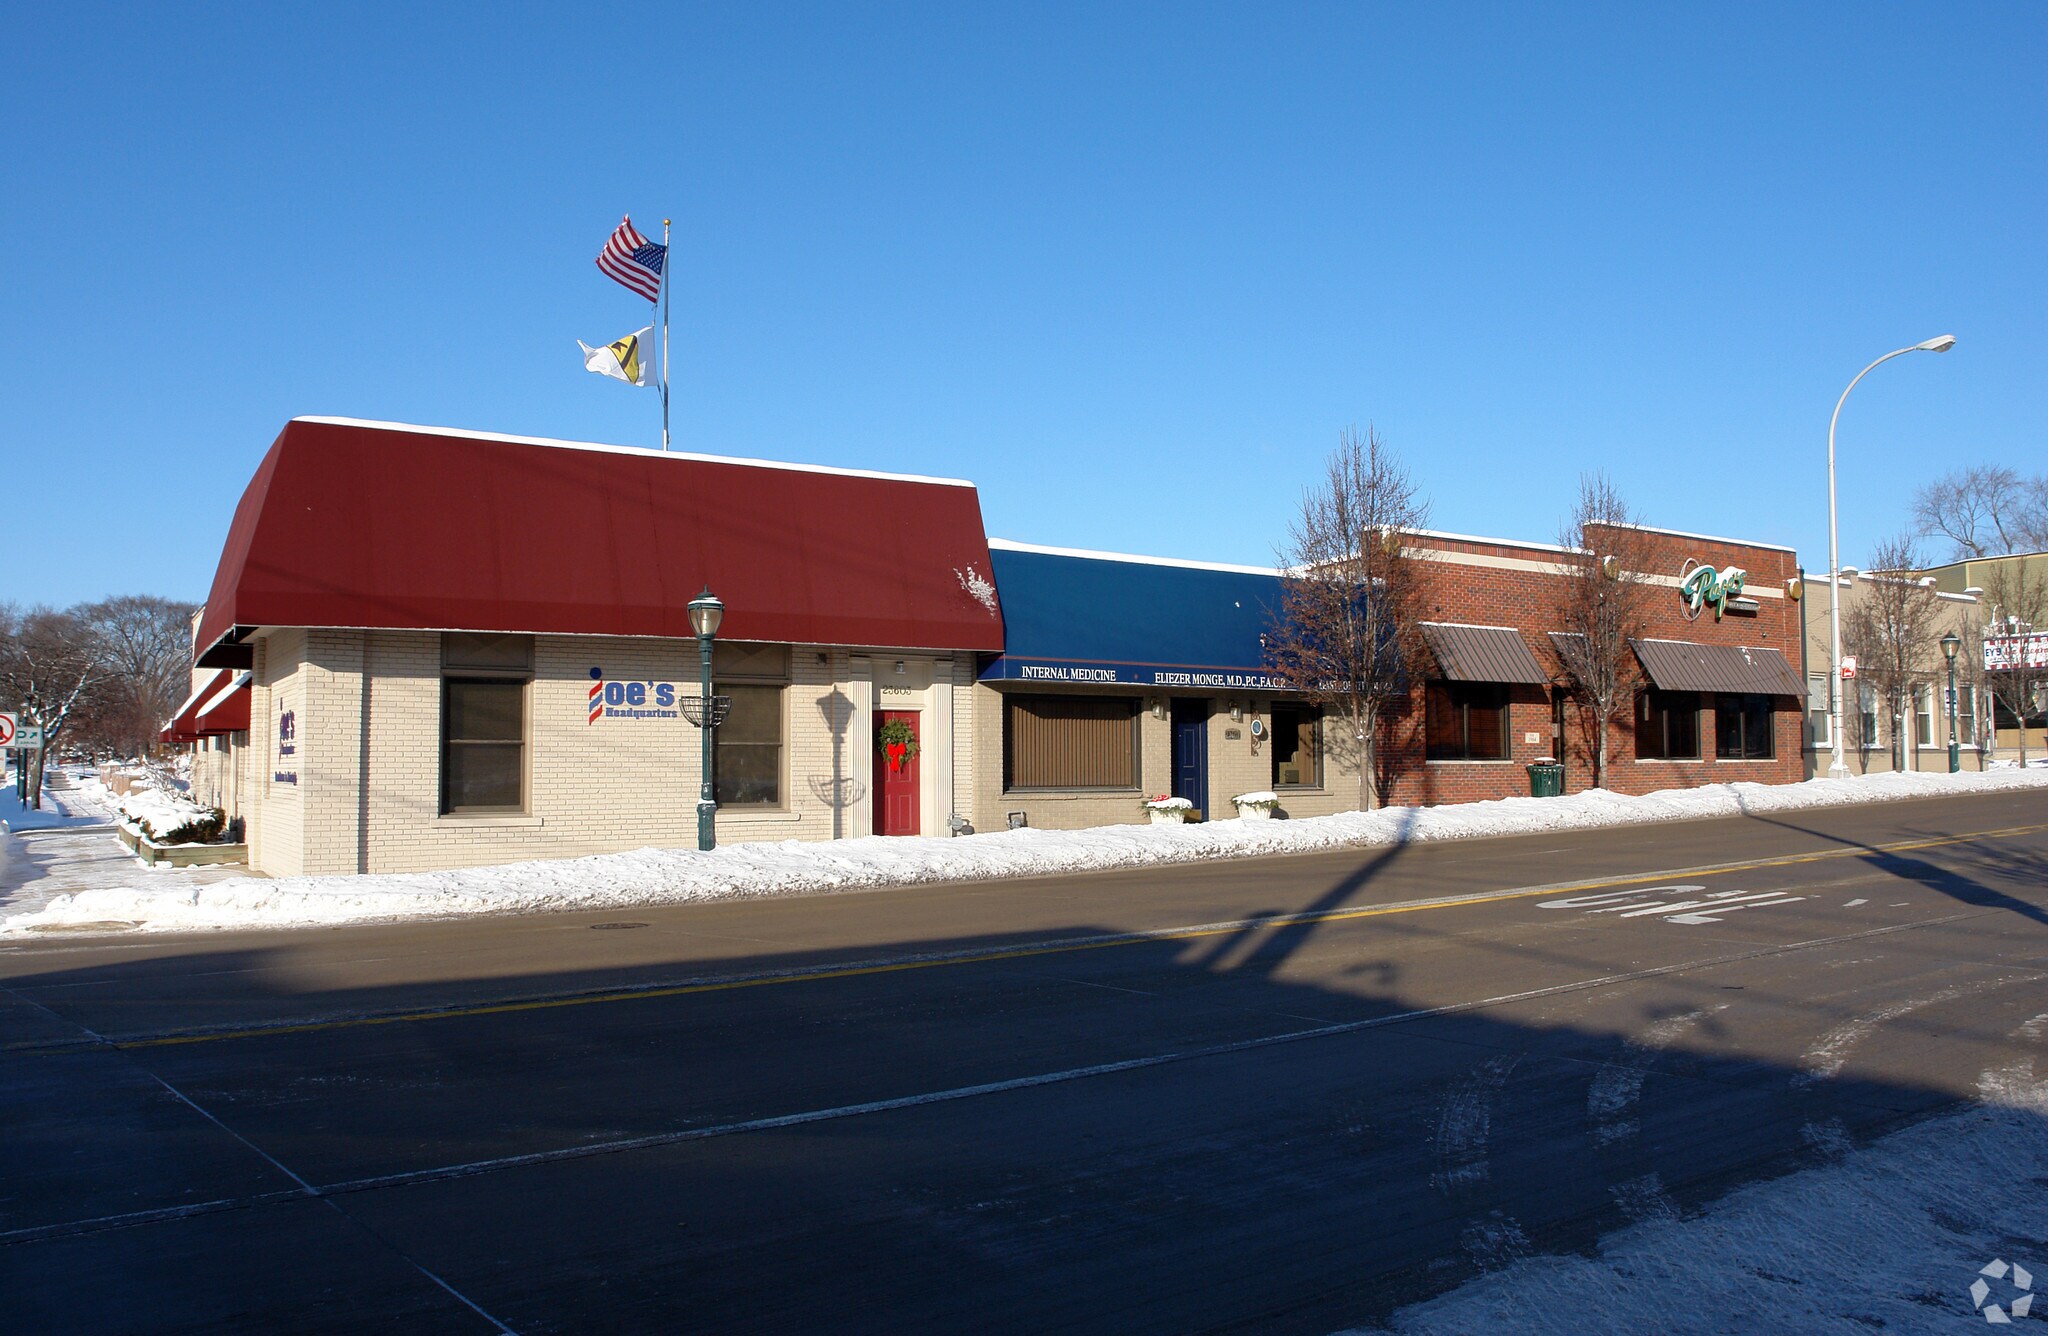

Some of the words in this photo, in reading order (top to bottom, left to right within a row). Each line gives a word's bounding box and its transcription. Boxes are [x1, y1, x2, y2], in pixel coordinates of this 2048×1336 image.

[1021, 666, 1069, 680] INTERNAL
[1070, 668, 1116, 682] MEDICINE
[1154, 672, 1191, 685] ELIEZER
[1192, 673, 1226, 687] MONGE,
[605, 707, 678, 719] Headquarters
